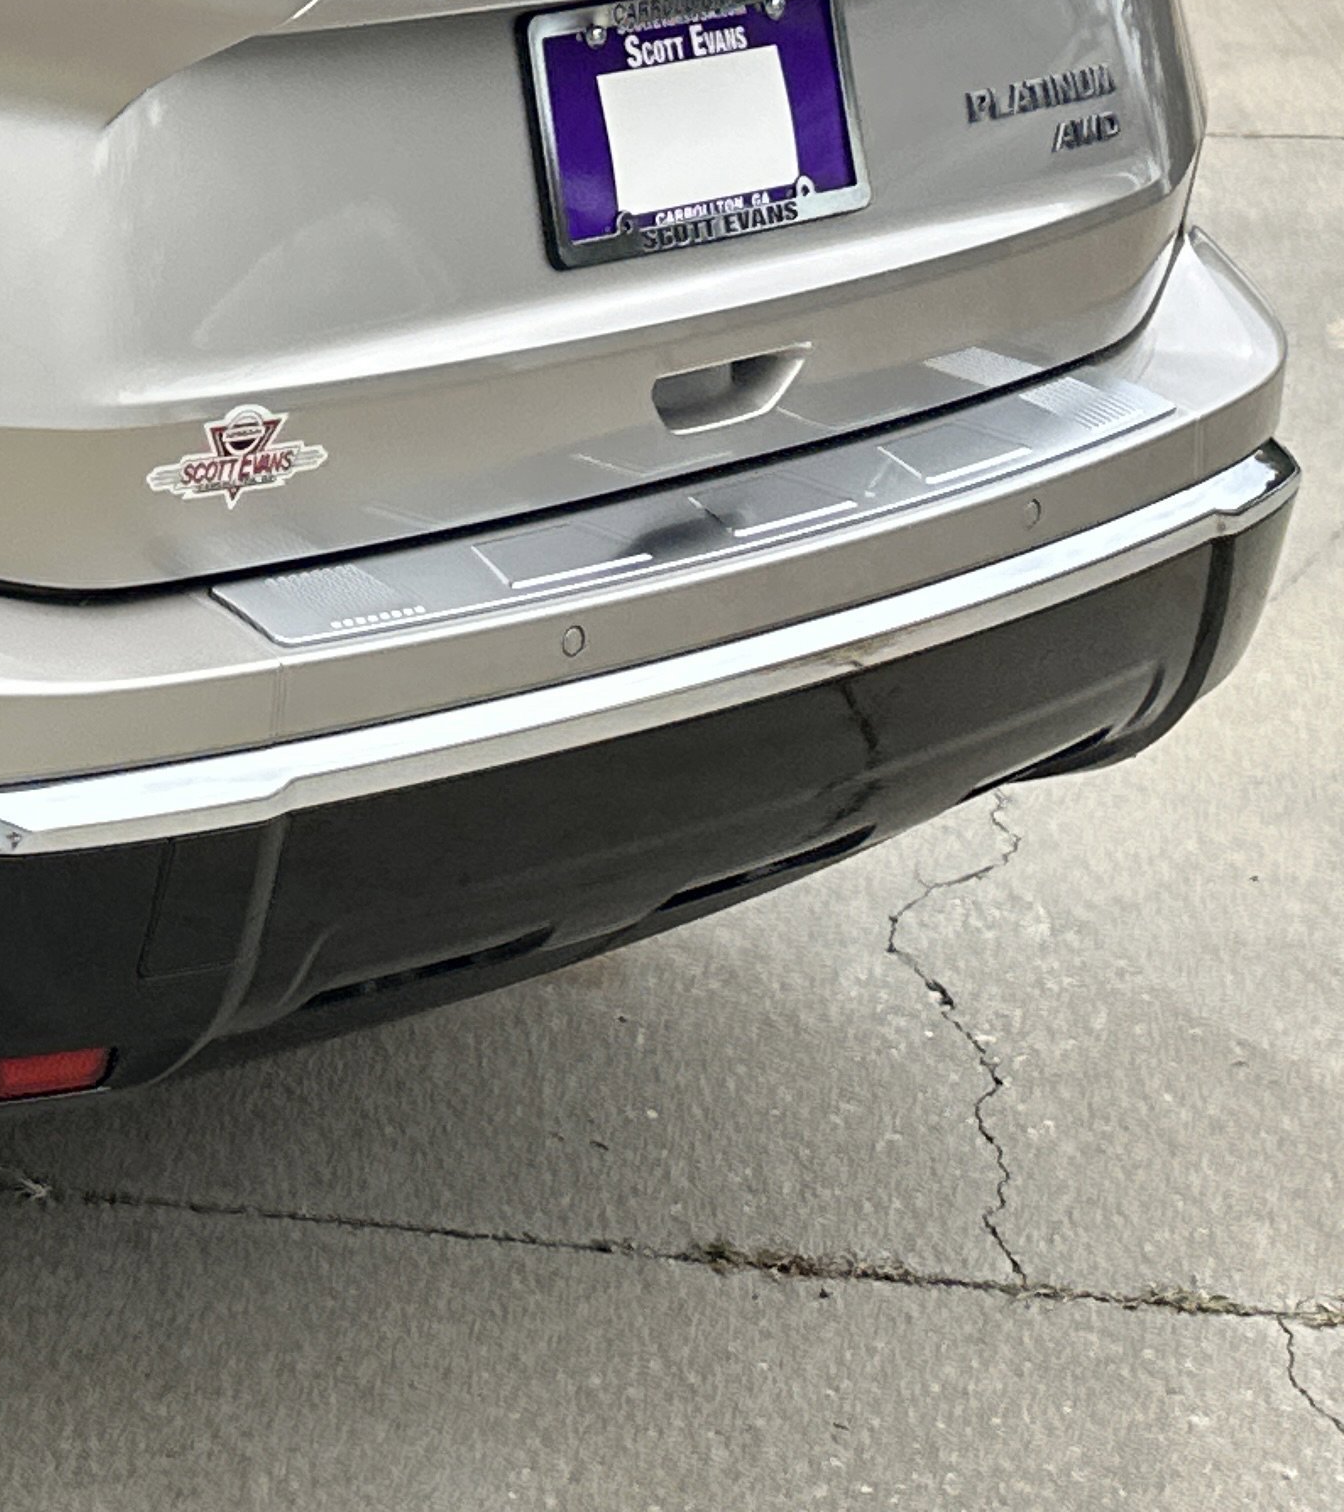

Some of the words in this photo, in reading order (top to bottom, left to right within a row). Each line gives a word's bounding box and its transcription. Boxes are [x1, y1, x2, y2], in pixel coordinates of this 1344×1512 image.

[965, 63, 1116, 124] PLATINUM
[1051, 110, 1121, 153] AWD
[641, 216, 716, 251] SCOTT
[723, 201, 799, 234] EVANS
[180, 458, 239, 485] SCOTT
[238, 449, 294, 481] EVANS
